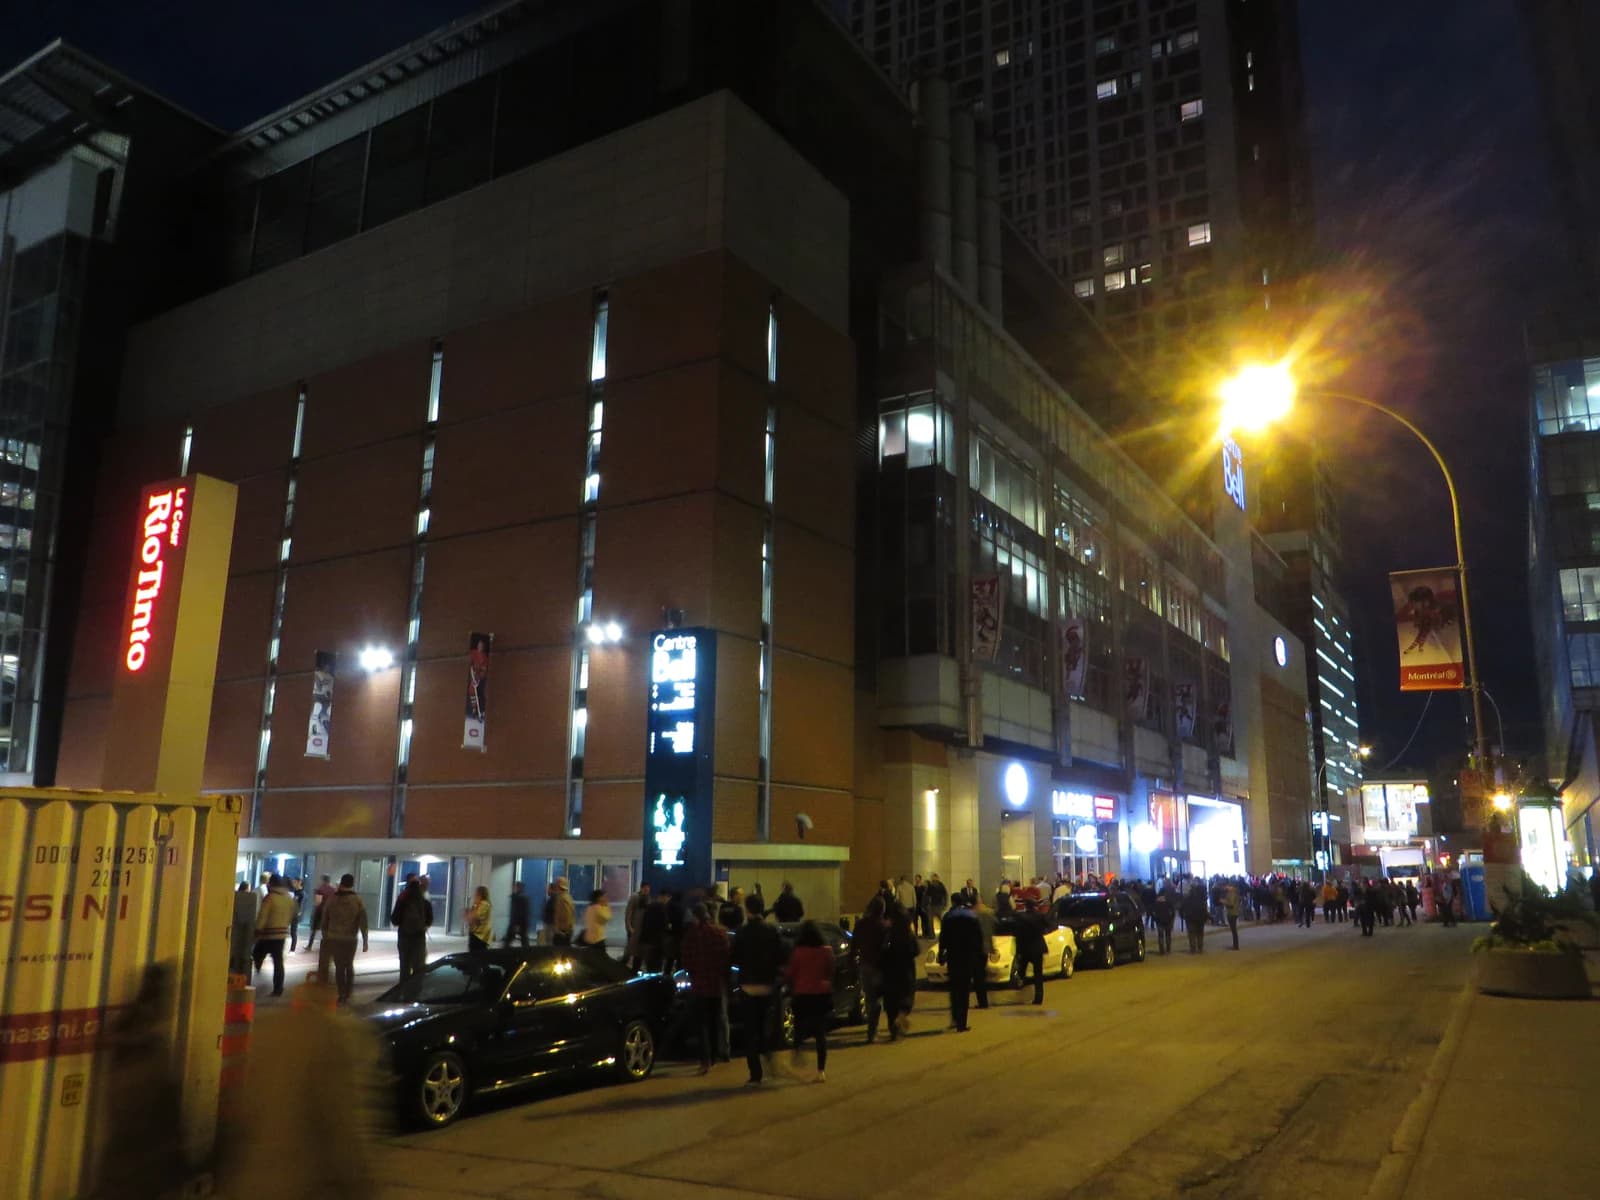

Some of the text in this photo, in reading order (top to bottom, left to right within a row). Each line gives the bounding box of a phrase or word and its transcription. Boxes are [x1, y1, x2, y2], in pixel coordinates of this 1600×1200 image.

[1223, 447, 1245, 511] Bell
[170, 509, 184, 546] Cour
[654, 634, 697, 651] Centre
[1407, 671, 1445, 681] Montréal
